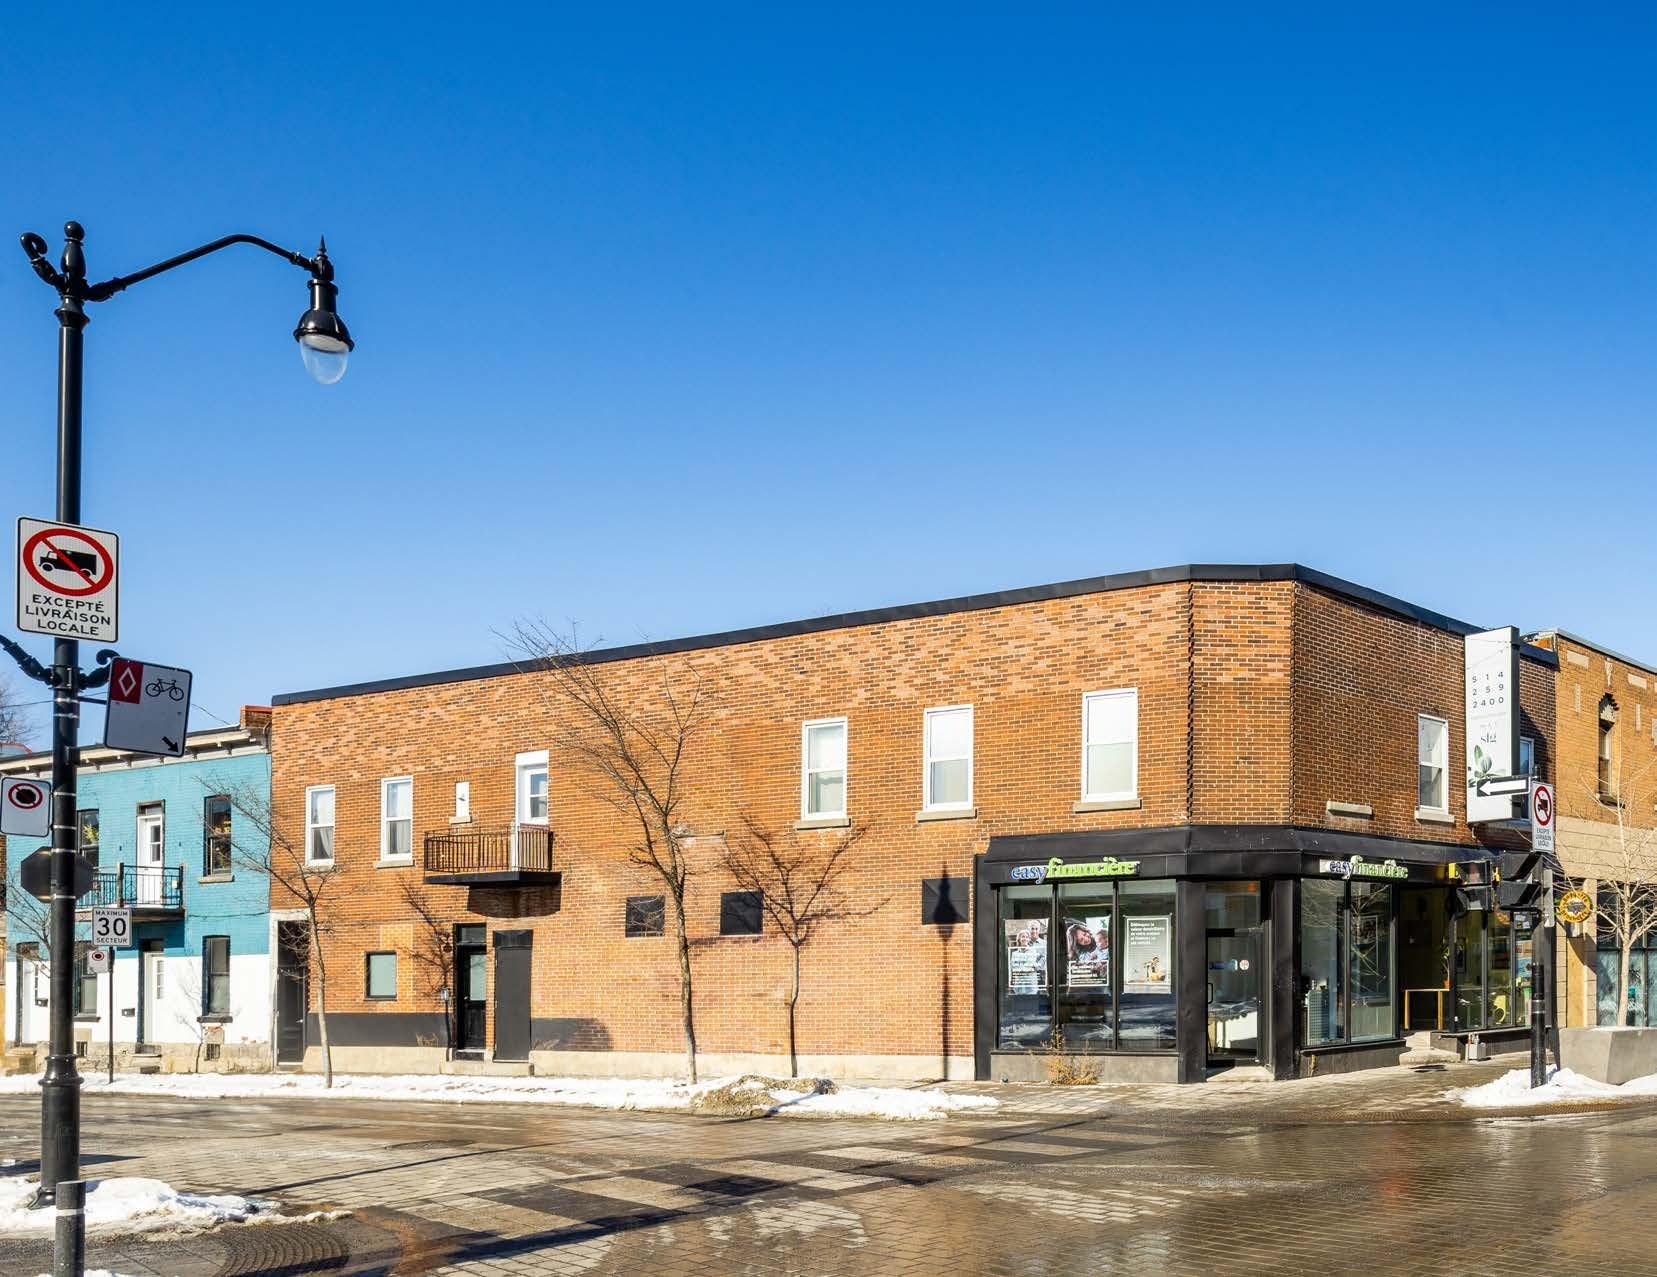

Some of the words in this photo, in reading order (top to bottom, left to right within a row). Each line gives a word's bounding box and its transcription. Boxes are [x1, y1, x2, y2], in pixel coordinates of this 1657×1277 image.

[32, 594, 105, 613] EXCEPTÉ
[26, 605, 111, 625] LIVRAISON
[37, 619, 99, 636] LOCALE
[97, 917, 127, 937] 30
